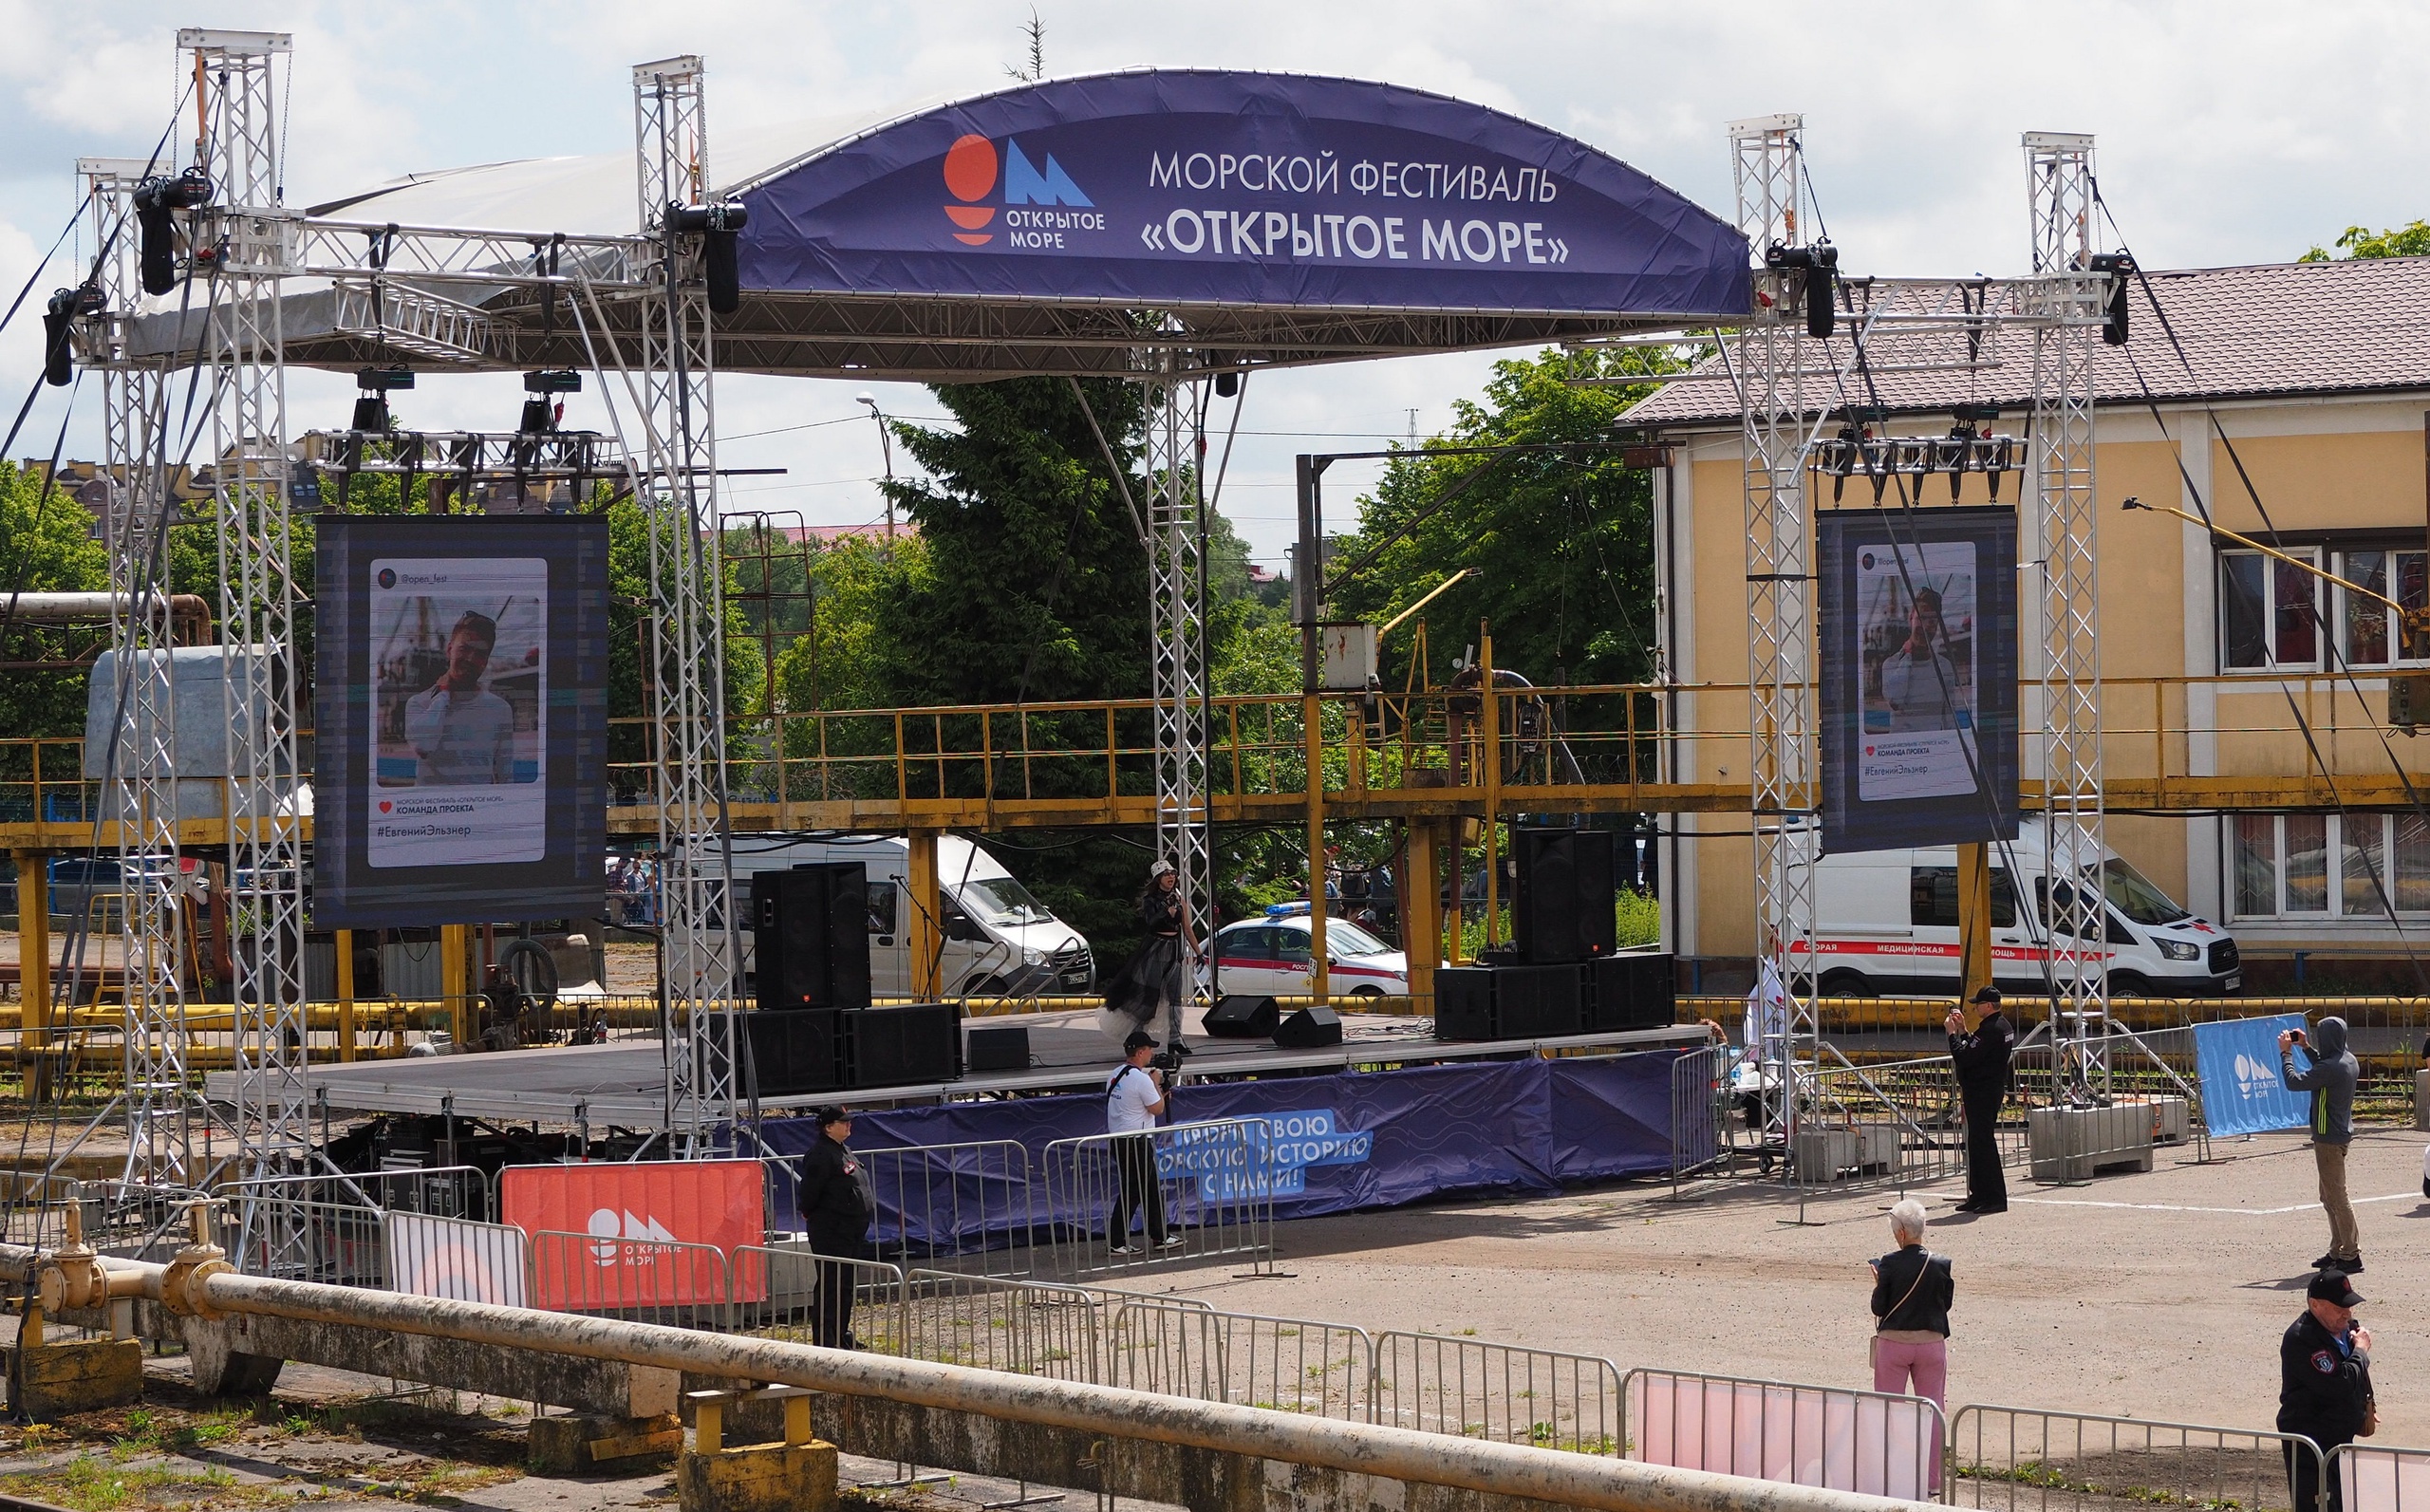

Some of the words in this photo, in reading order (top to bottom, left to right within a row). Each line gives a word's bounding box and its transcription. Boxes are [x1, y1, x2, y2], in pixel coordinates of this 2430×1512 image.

[1149, 149, 1339, 196] МОРСКОЙ
[1349, 159, 1558, 204] ФЕСТИВАЛЬ
[1006, 210, 1106, 231] ОТКРЫТОЕ
[1010, 231, 1065, 250] МОРЕ
[1141, 208, 1409, 261] «ОТКРЫТОЕ
[1421, 219, 1570, 266] МОРЕ»
[402, 573, 447, 585] @open_fest
[1878, 749, 1905, 757] КОМАНДА
[1906, 747, 1930, 756] ПРОЕКТА
[396, 805, 437, 814] КОМАНДА
[438, 804, 475, 813] ПРОЕКТА
[378, 824, 472, 837] #ЕвгенийЭльзнер
[1877, 944, 1944, 954] МЕДИЦИНСКАЯ
[1260, 1115, 1328, 1140] СВОЮ
[1158, 1146, 1245, 1173] ОРСКУЮ
[1261, 1137, 1368, 1165] ИСТОРИЮ
[1224, 1168, 1299, 1193] НАМИ!
